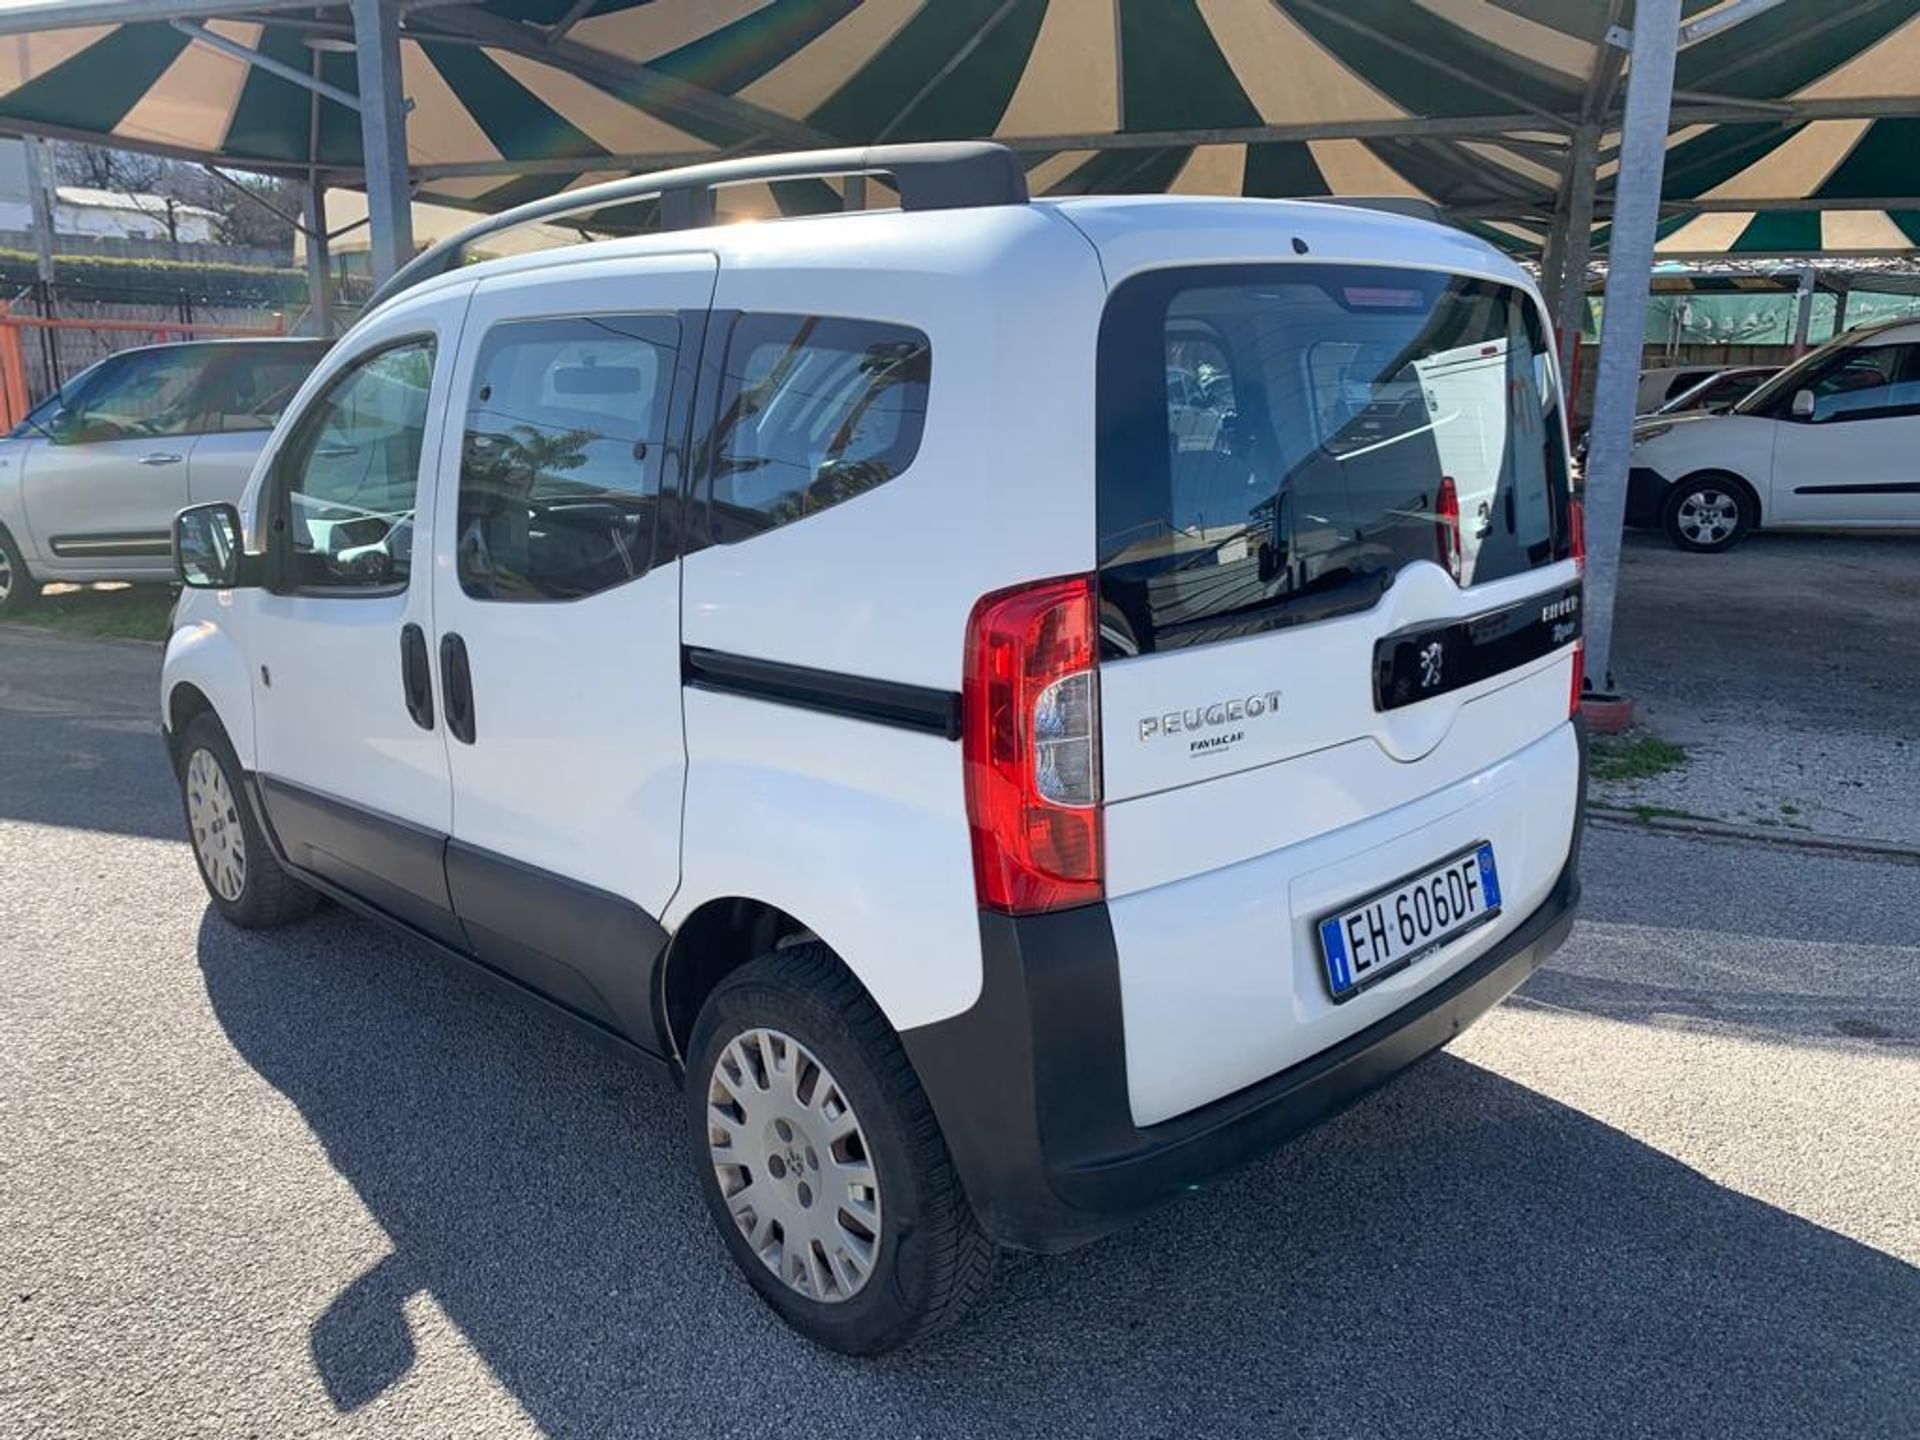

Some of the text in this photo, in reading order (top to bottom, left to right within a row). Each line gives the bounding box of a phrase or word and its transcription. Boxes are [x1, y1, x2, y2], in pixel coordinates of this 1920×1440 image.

[1138, 690, 1282, 741] PEUGEOT
[1346, 859, 1478, 974] EH 606DF
